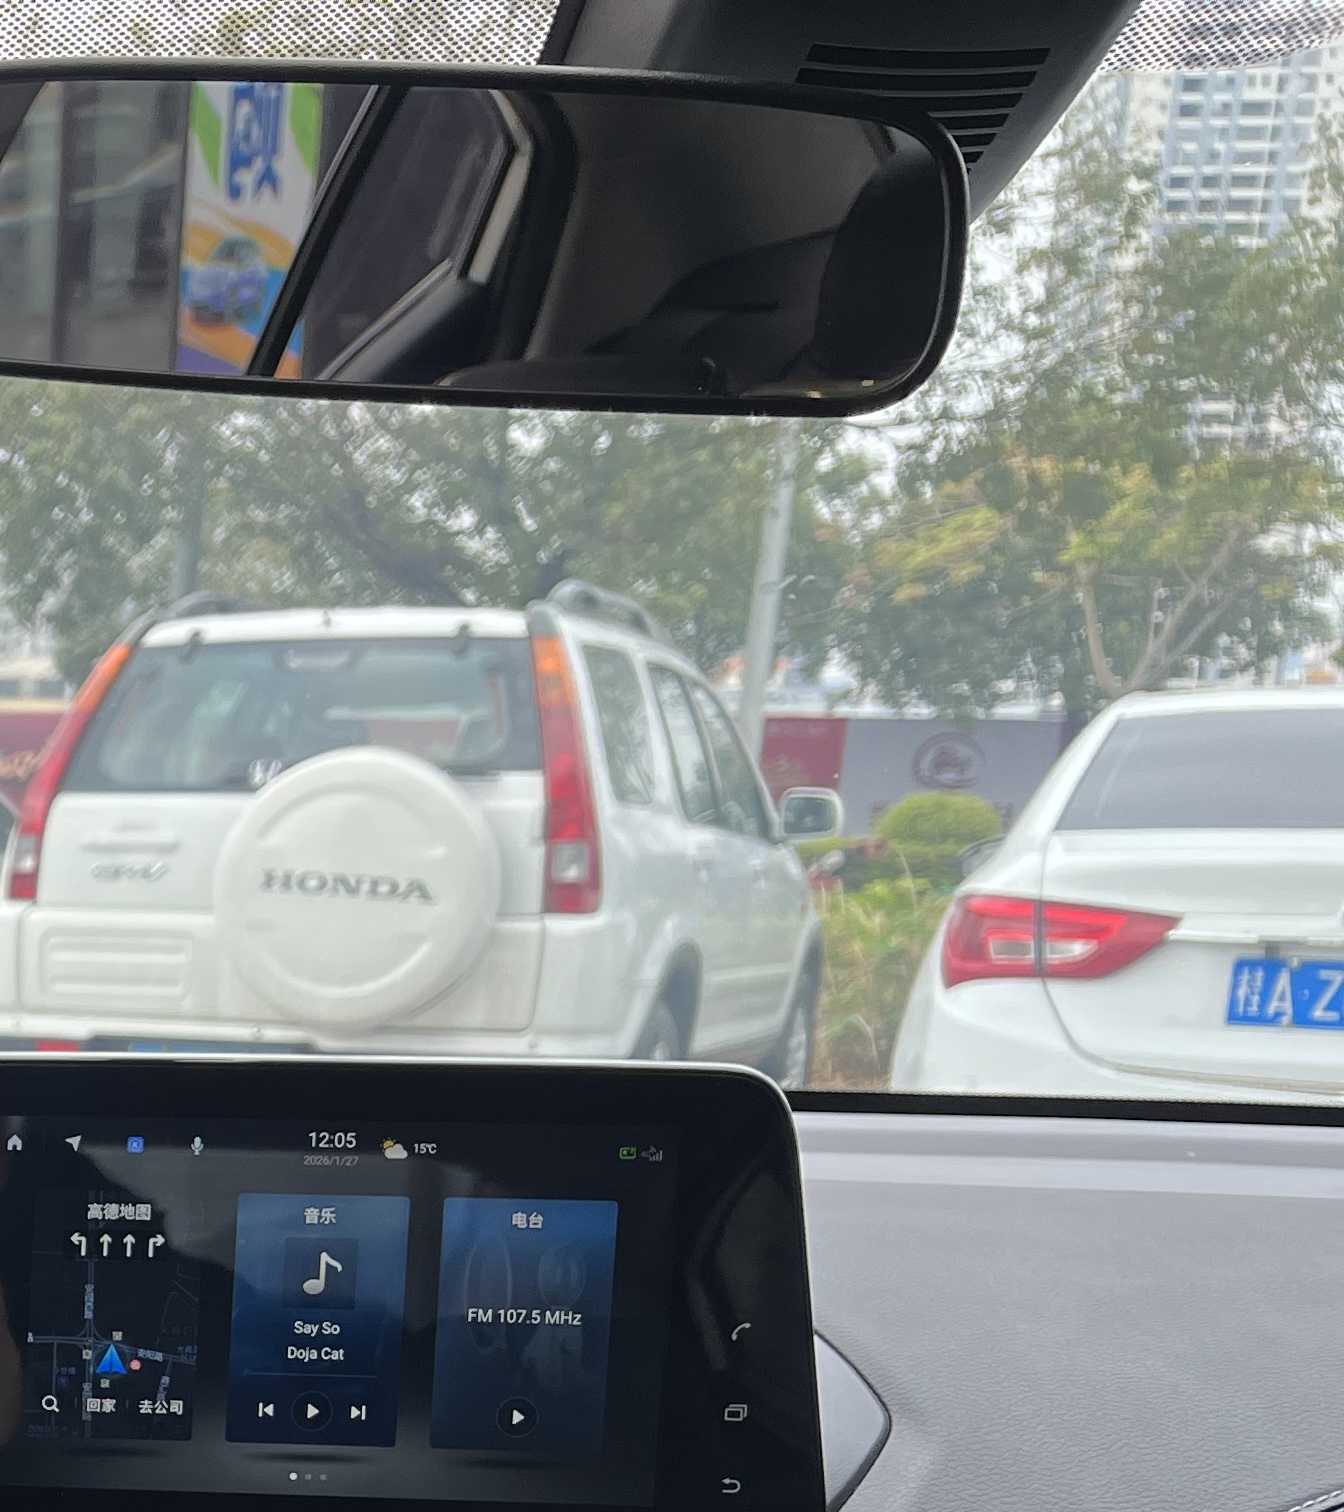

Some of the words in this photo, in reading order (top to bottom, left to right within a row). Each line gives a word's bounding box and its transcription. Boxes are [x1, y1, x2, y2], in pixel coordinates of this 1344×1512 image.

[261, 867, 435, 906] HONDA
[308, 1131, 357, 1149] 12:05
[303, 1155, 360, 1167] 2026/1/27
[87, 1203, 152, 1221] 高德地图
[304, 1207, 337, 1225] 音乐
[512, 1212, 544, 1229] 电台
[467, 1308, 493, 1324] FM
[497, 1309, 541, 1325] 107.5
[545, 1310, 582, 1326] MHz
[294, 1320, 319, 1338] Say
[322, 1321, 340, 1335] So
[287, 1346, 318, 1362] Doja
[321, 1347, 344, 1361] Cat
[86, 1398, 116, 1413] 回家
[138, 1399, 184, 1415] 去公司
